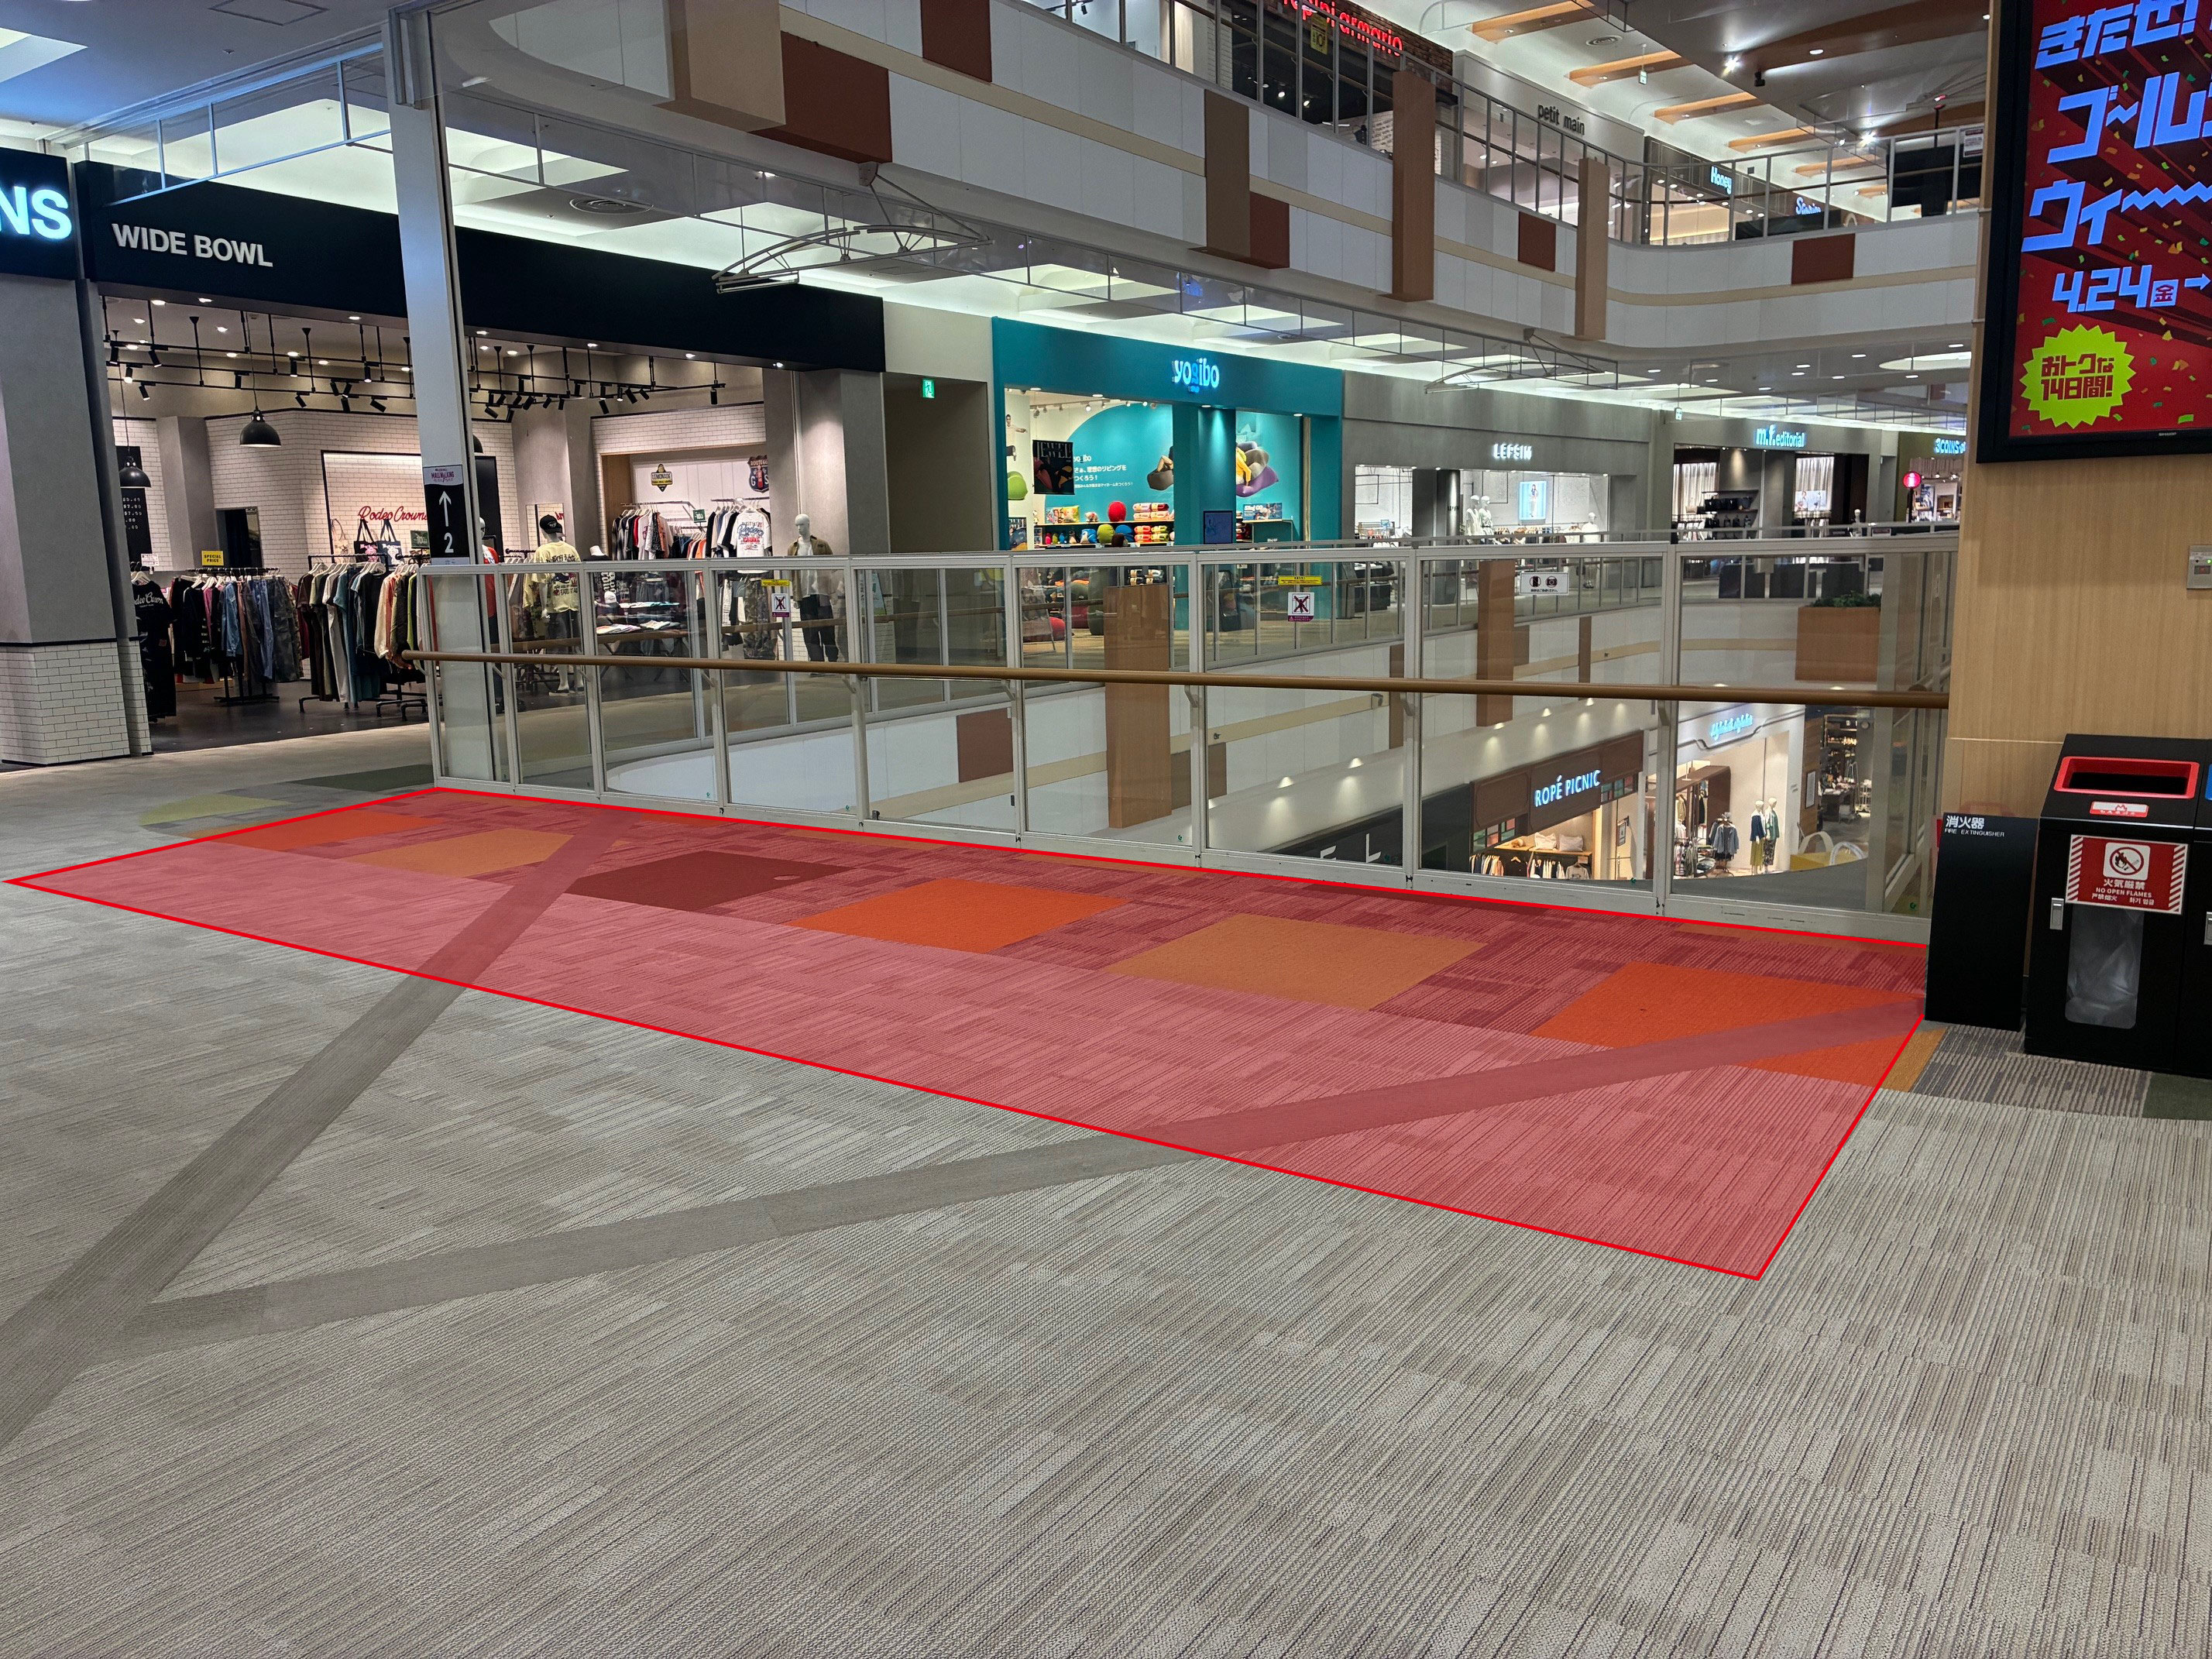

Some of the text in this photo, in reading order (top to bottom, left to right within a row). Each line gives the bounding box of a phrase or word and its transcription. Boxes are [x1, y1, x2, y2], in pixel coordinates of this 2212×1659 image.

[1339, 12, 1403, 57] armario
[1538, 104, 1585, 136] petit main
[2047, 72, 2212, 163] ゴール
[112, 223, 273, 267] WIDE BOWL
[1172, 358, 1220, 393] yogibo
[2042, 353, 2114, 376] おトクな
[2041, 375, 2114, 401] 14日間!
[358, 506, 393, 523] Rodeo
[444, 532, 455, 554] 2
[1535, 769, 1601, 807] ROPÉ PICNIC
[1946, 816, 1985, 830] 消火器
[1961, 829, 2004, 837] EXTINGUISHER
[2104, 878, 2145, 890] 火気厳禁
